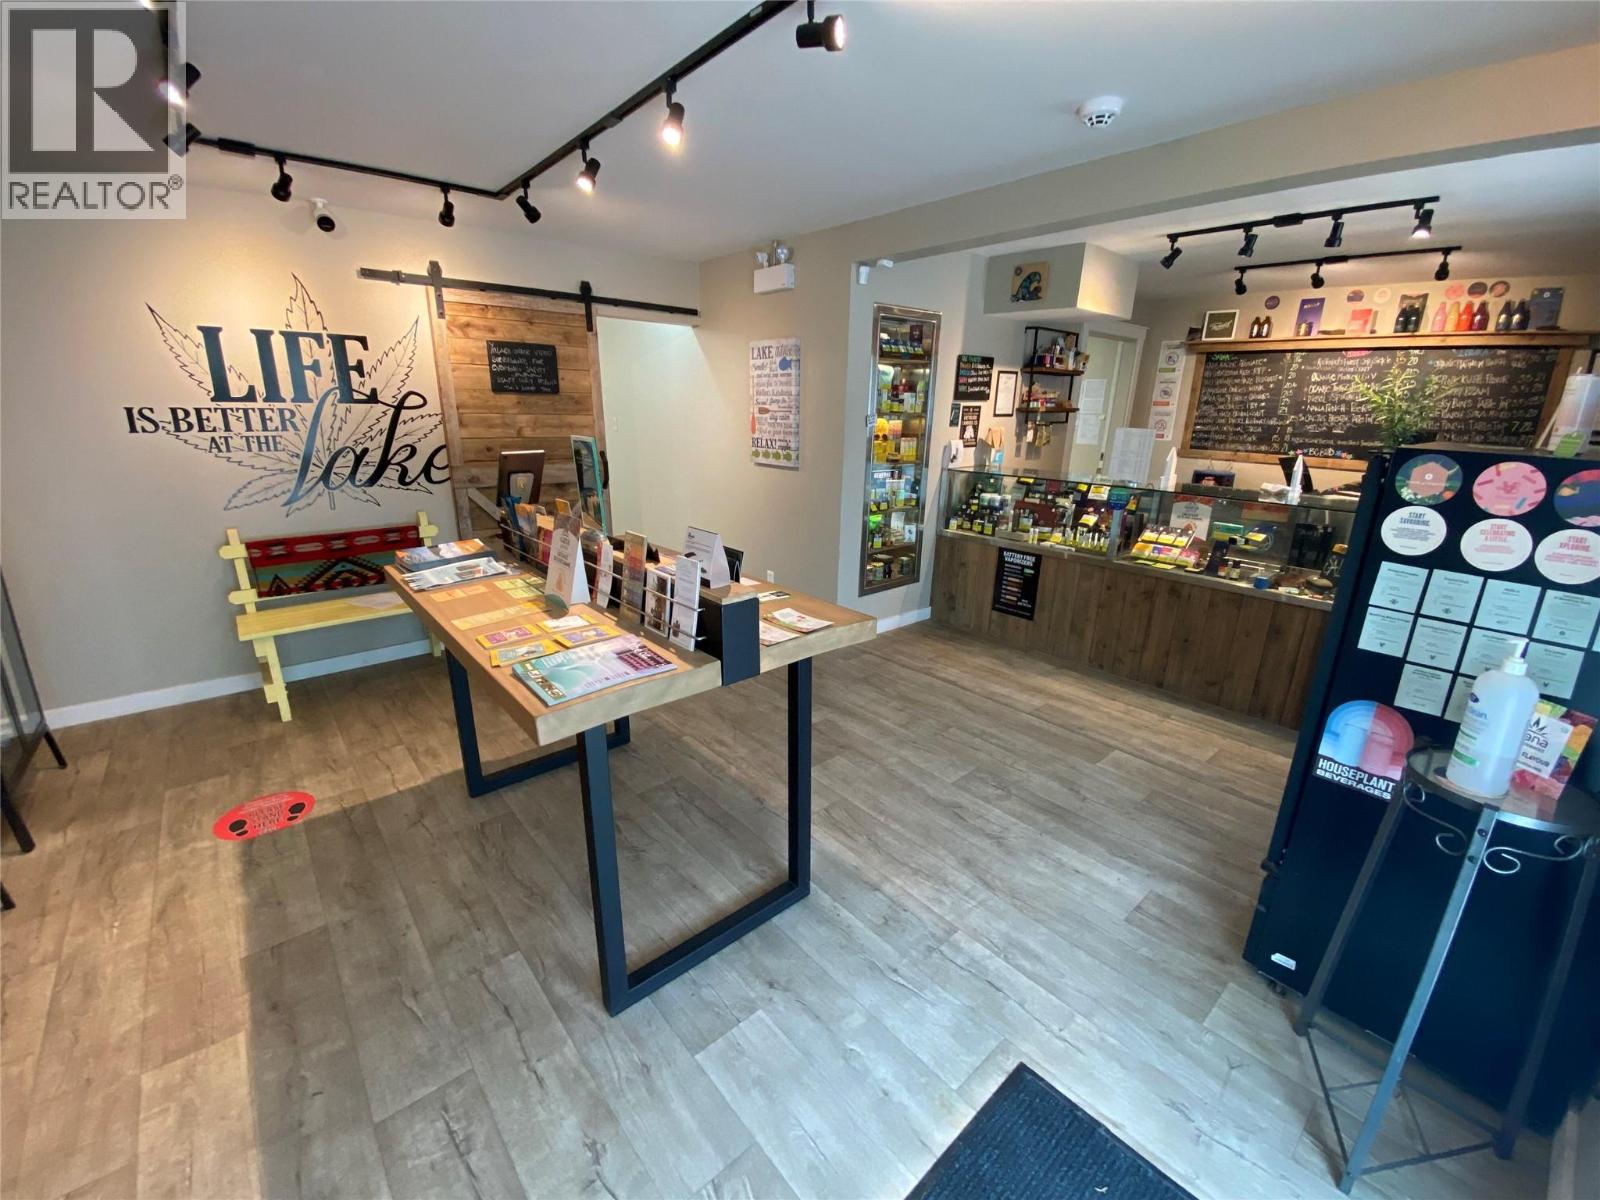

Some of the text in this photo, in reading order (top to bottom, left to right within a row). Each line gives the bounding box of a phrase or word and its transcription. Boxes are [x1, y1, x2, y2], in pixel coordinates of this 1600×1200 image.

[751, 346, 773, 360] LAKE
[197, 325, 379, 405] LIFE
[123, 407, 299, 434] IS BETTER
[207, 435, 286, 453] AT THE
[751, 437, 777, 449] RELAX!
[1408, 511, 1426, 519] START
[1316, 768, 1392, 800] BEVERAGES
[1318, 758, 1396, 792] HOUSEPLANT
